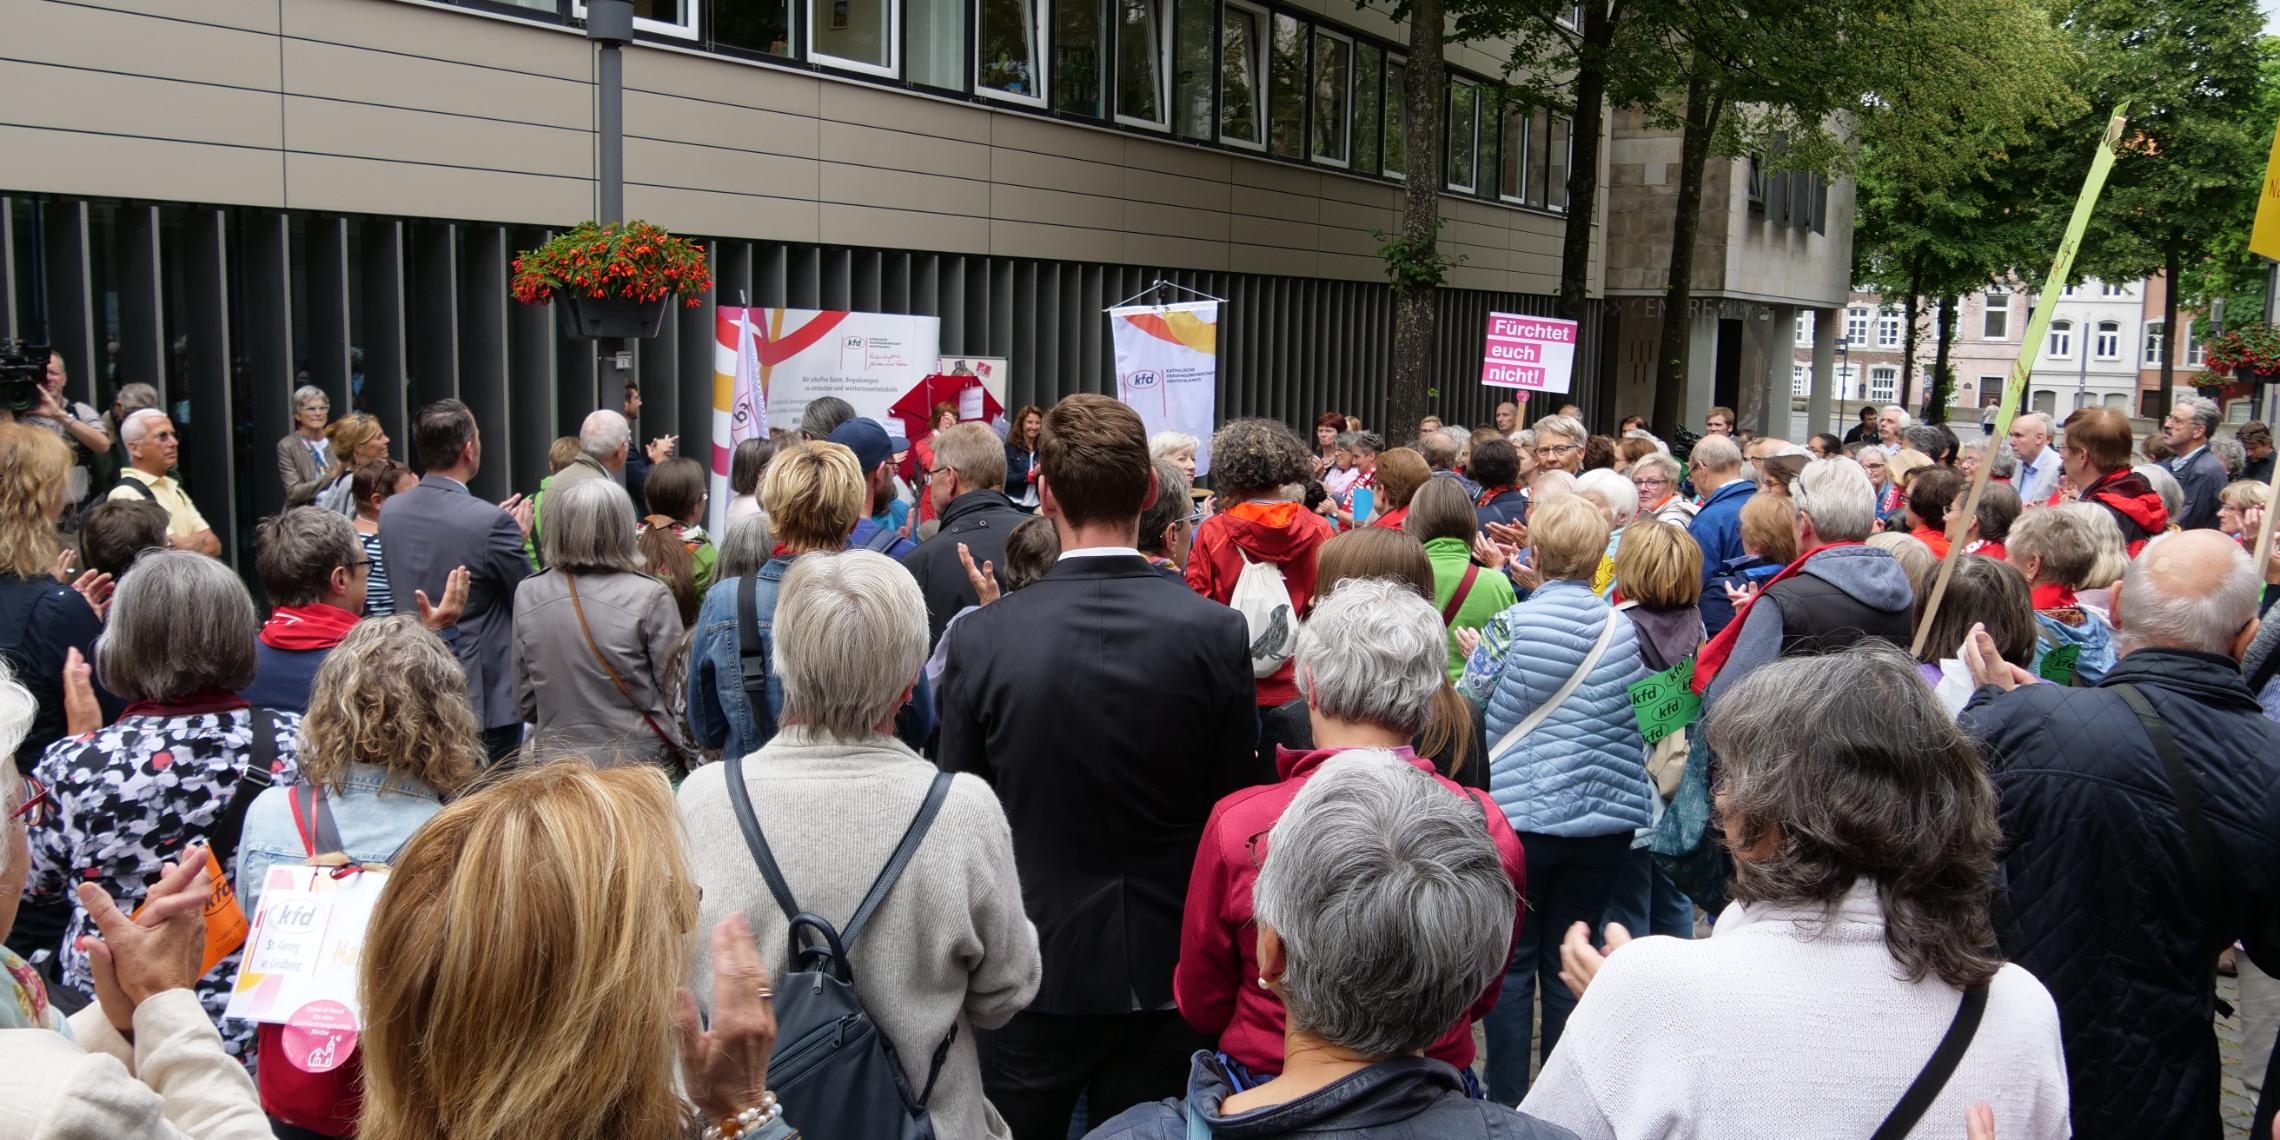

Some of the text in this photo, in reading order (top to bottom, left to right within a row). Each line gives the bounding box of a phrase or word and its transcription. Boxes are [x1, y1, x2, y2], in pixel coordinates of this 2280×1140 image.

[1630, 298, 1713, 318] CENRE
[1494, 319, 1570, 341] Fürchtet
[847, 338, 862, 347] kfd
[1491, 344, 1535, 361] euch
[1134, 373, 1154, 386] kfd
[1488, 366, 1539, 385] nicht!
[1682, 678, 1693, 692] kf
[1632, 686, 1657, 705] kfd
[1659, 699, 1679, 719] kfd
[277, 904, 317, 928] kfd
